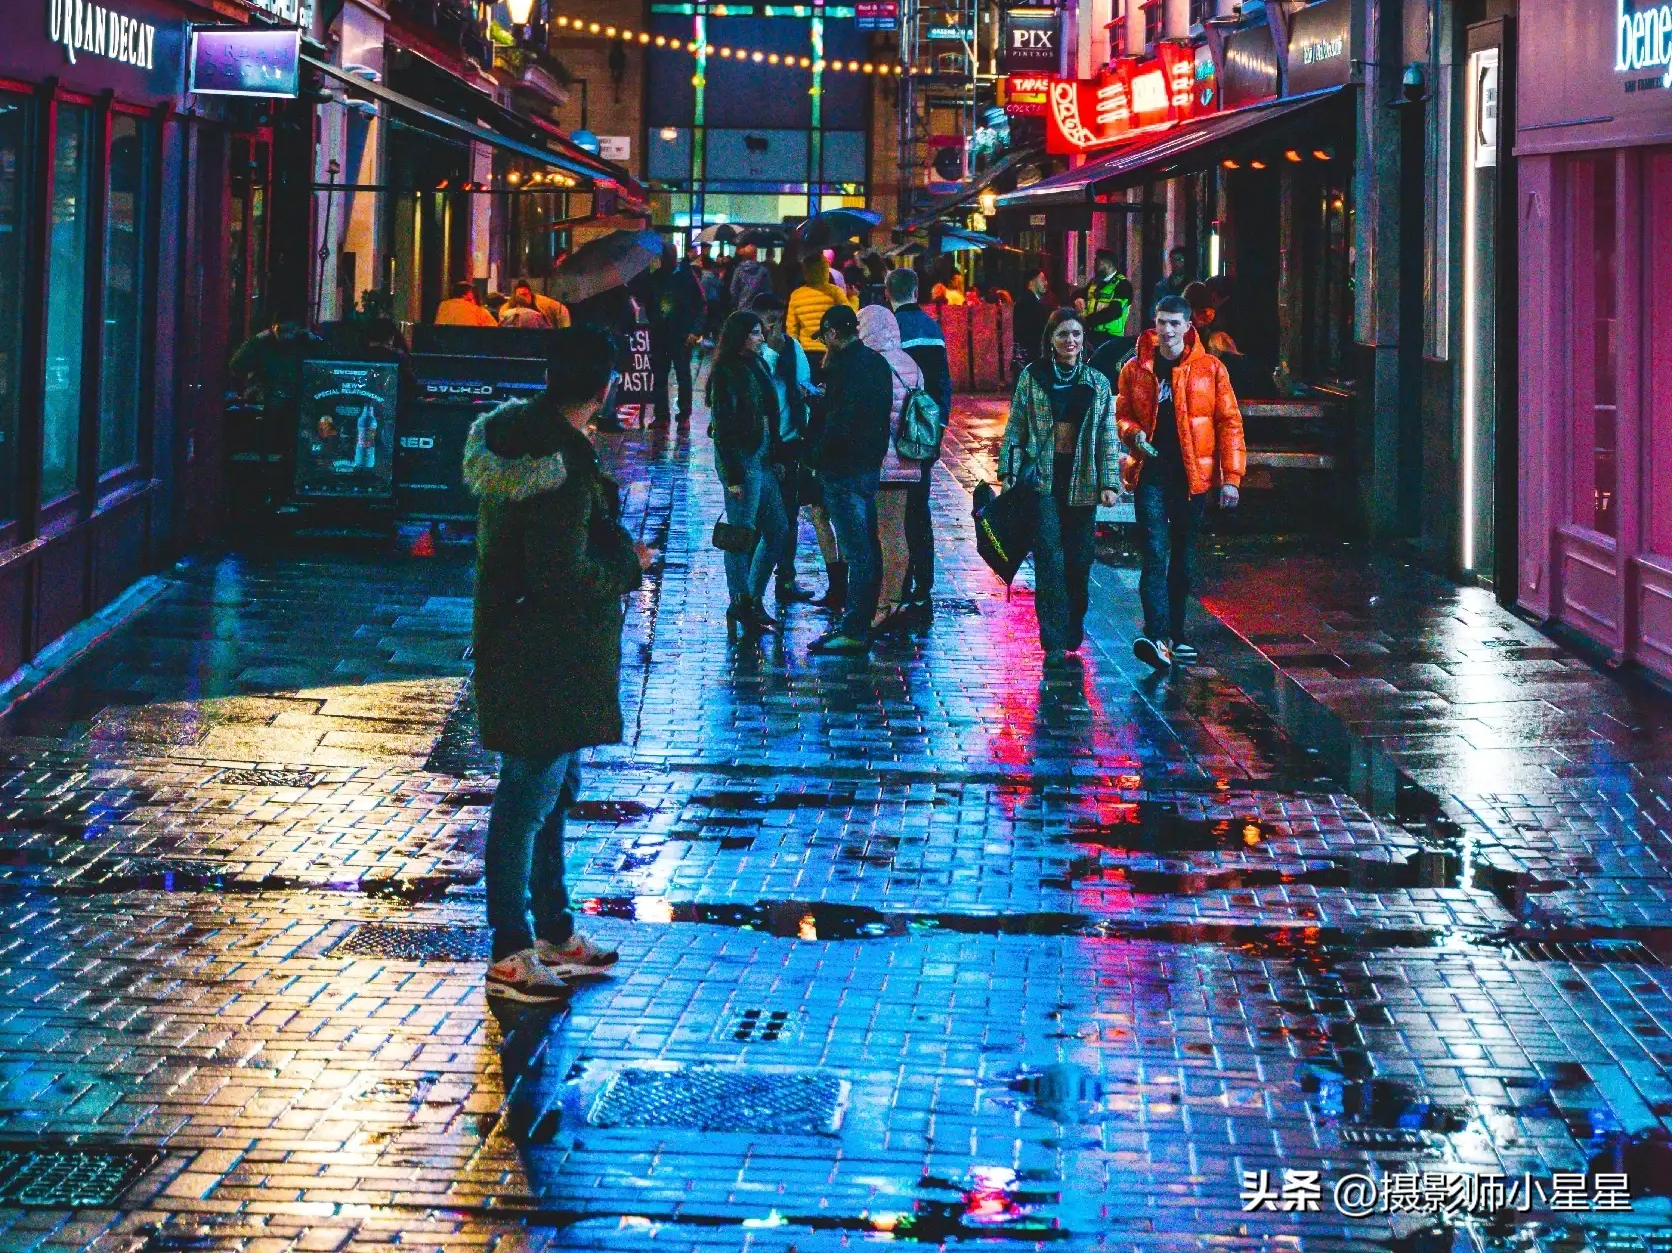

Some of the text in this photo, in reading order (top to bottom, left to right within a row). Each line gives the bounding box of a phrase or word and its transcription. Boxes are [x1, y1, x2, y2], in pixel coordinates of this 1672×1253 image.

[108, 11, 155, 70] DECAY
[1012, 29, 1053, 48] PIX
[1013, 79, 1049, 91] TAPAS
